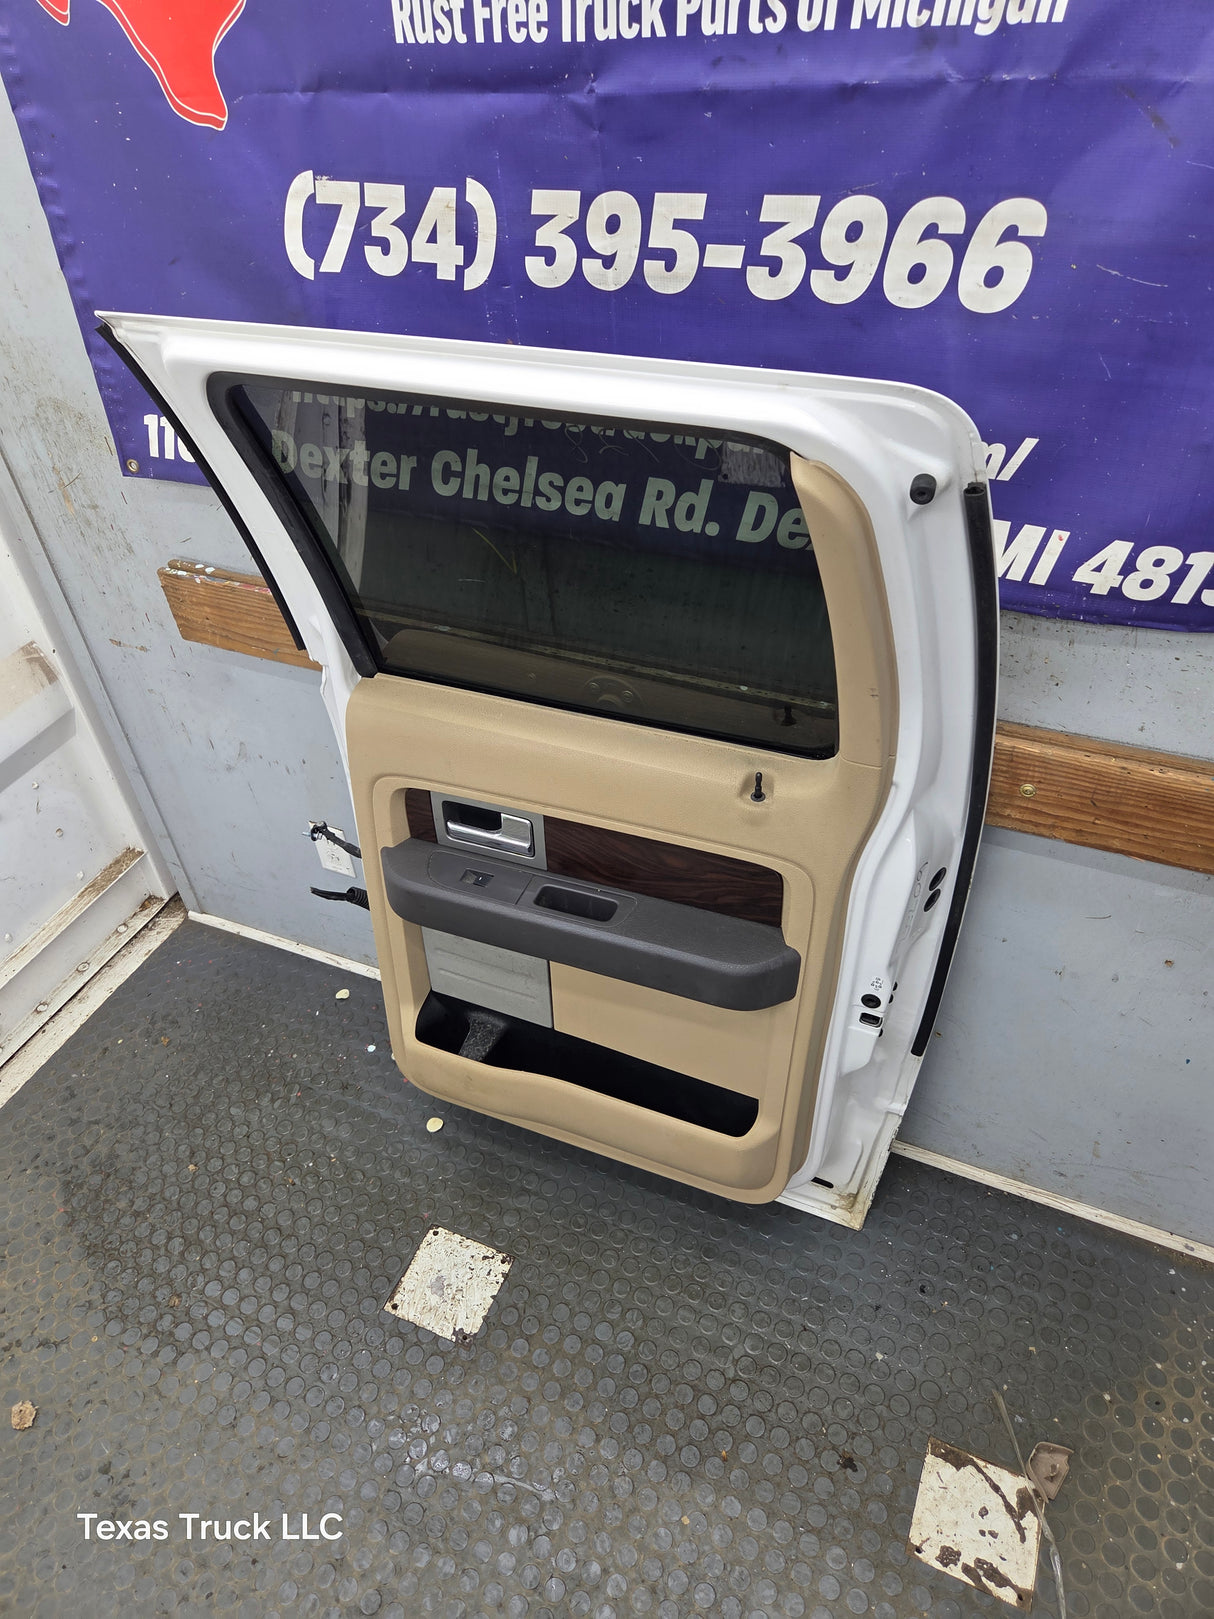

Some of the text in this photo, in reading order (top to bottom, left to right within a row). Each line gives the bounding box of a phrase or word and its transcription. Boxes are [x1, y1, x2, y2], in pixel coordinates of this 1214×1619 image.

[391, 0, 467, 44] Rust
[472, 0, 549, 43] Free
[560, 0, 667, 43] Truck
[676, 0, 787, 36] Parts
[283, 170, 1049, 313] (734) 395-3966
[272, 430, 417, 491] Dexter
[431, 448, 627, 522] Chelsea
[638, 476, 720, 537] Rd.
[735, 490, 813, 550] De
[992, 519, 1070, 585] MI
[1072, 540, 1214, 607] 481
